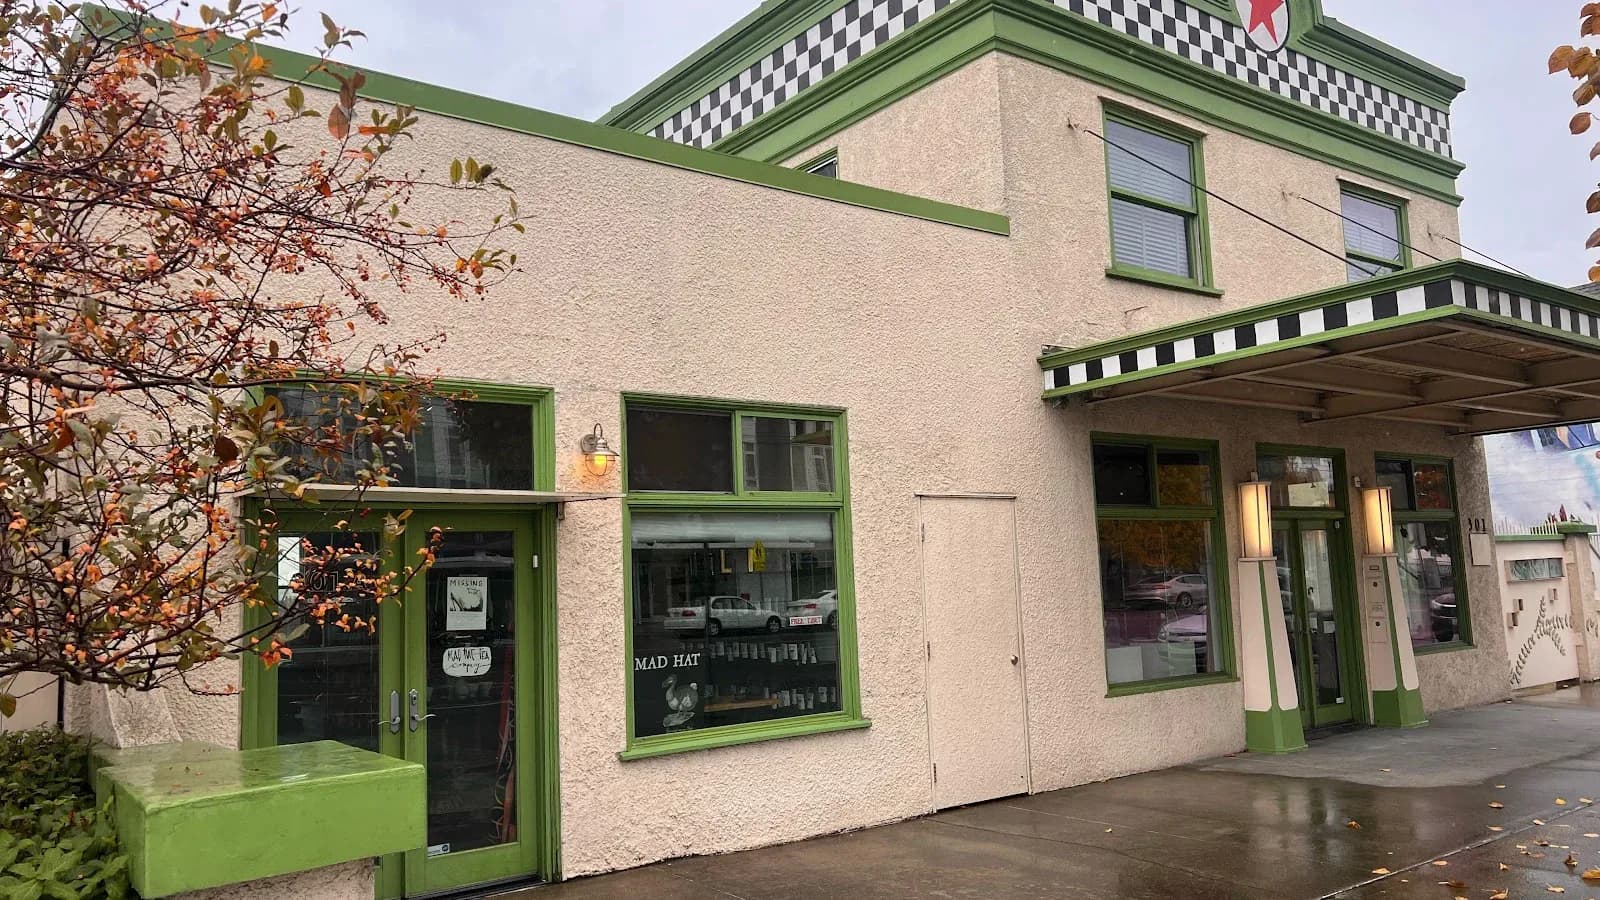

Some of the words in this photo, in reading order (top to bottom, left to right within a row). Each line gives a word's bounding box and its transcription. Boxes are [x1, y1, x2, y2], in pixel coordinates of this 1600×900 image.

[1467, 518, 1486, 532] 301
[449, 579, 483, 587] MISSING
[634, 655, 668, 671] MAD
[672, 652, 701, 668] HAT
